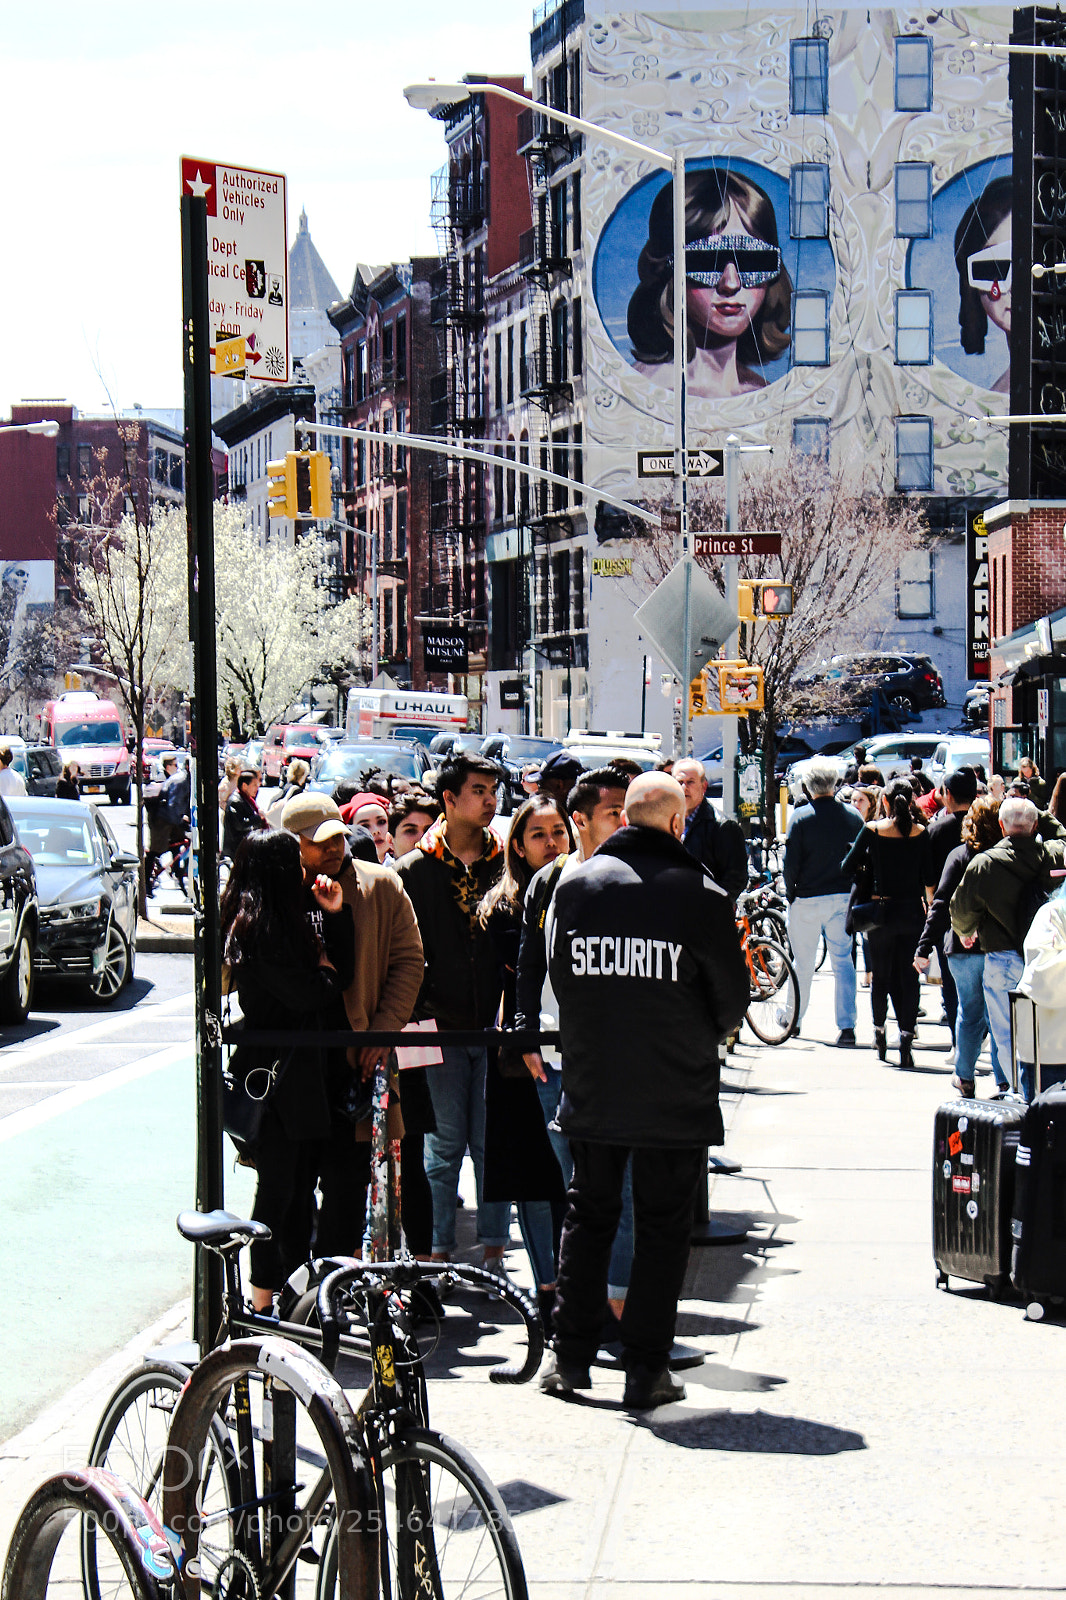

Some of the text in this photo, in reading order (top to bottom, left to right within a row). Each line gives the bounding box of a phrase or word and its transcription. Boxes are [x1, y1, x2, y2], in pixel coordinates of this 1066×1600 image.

[222, 171, 278, 194] Authorized
[222, 190, 265, 209] Vehicles
[222, 206, 245, 225] Only
[212, 237, 237, 257] Dept
[235, 301, 264, 322] Friday
[650, 458, 710, 469] ONE WAY
[695, 537, 754, 554] Prince St
[973, 537, 989, 639] PARK
[427, 636, 465, 646] MAISON
[395, 701, 455, 714] U-HAUL
[571, 936, 683, 982] SECURITY
